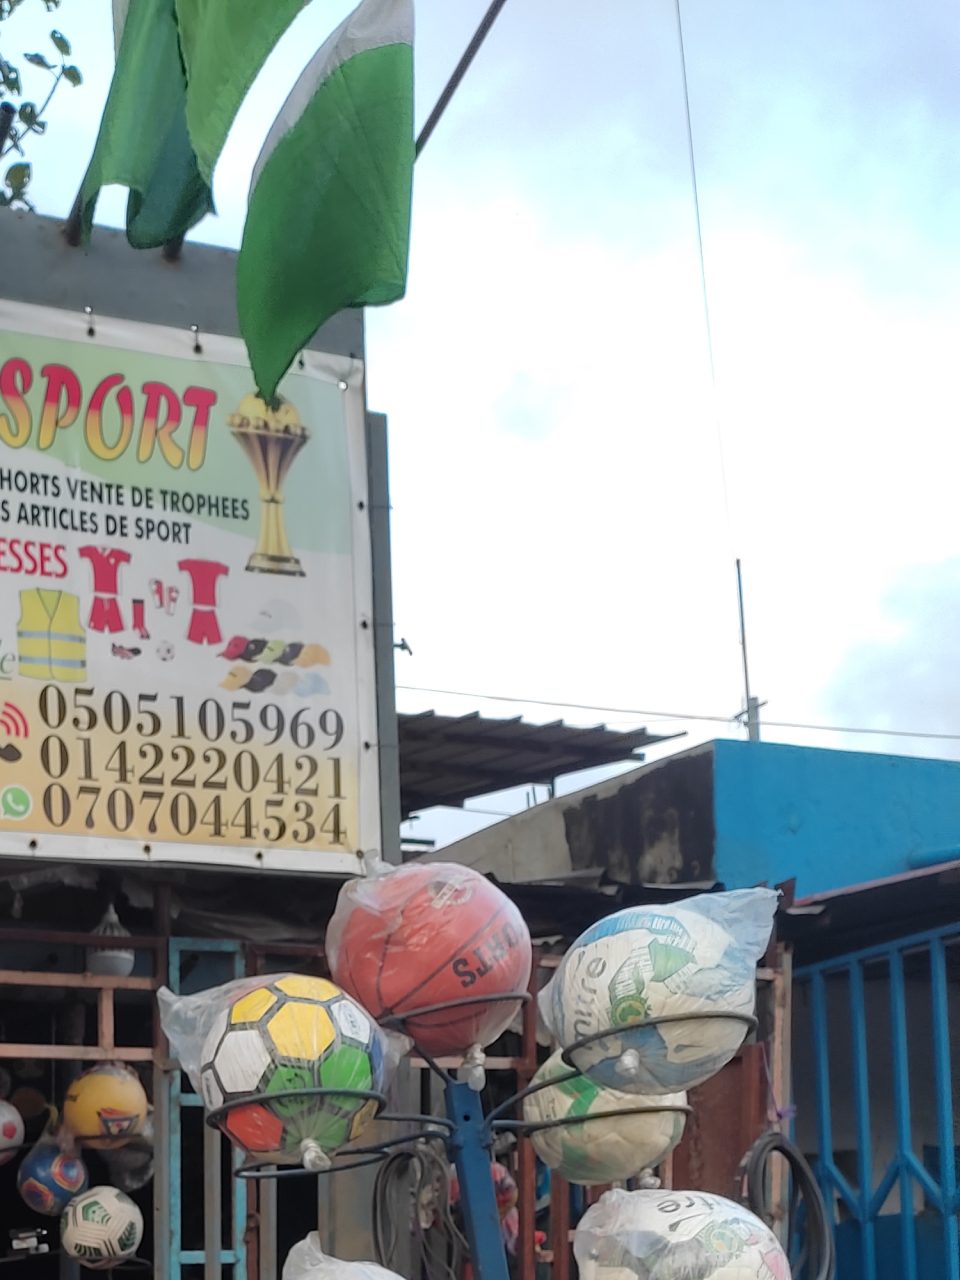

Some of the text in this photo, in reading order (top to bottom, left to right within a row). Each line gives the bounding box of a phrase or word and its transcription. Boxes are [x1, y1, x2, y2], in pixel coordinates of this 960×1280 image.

[16, 501, 98, 536] ARTICLES
[106, 515, 128, 537] DE
[135, 518, 192, 545] SPORT
[67, 476, 124, 505] VENTE
[131, 486, 155, 509] DE
[160, 490, 250, 520] TROPHEES
[38, 684, 345, 751] 0505105969
[40, 735, 347, 799] 0142220421
[42, 783, 347, 846] 0707044534
